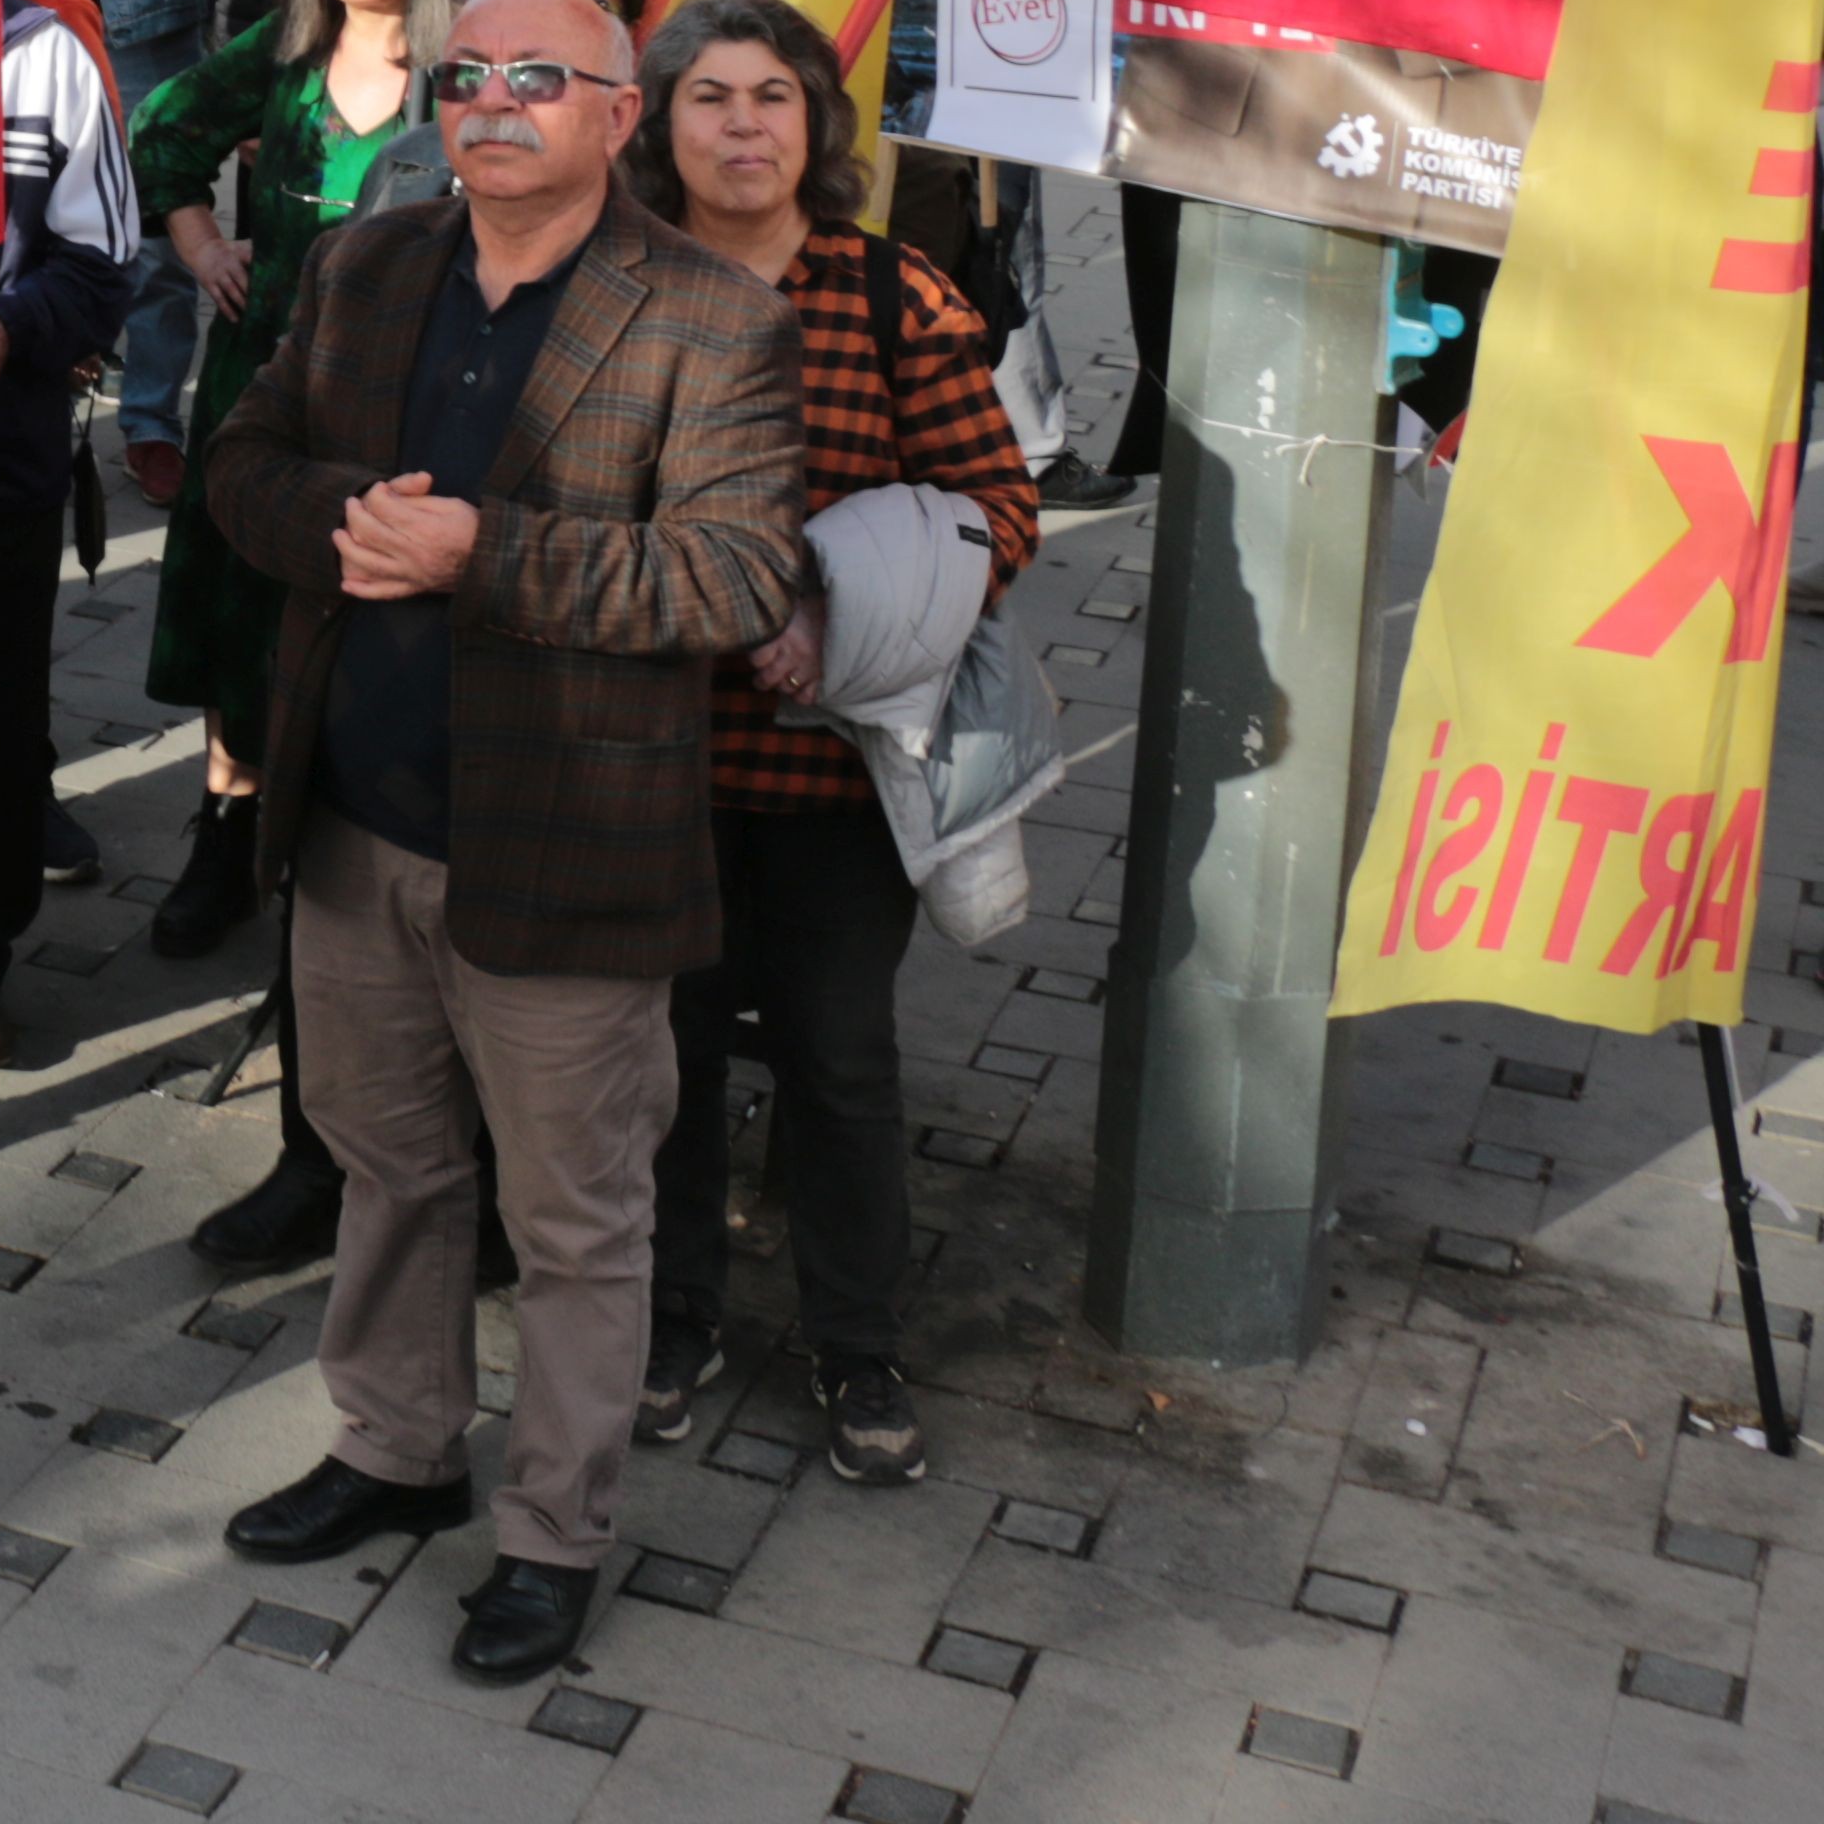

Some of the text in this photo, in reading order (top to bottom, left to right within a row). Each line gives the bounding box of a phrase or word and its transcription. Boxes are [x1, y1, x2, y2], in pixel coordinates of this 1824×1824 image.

[1407, 124, 1523, 168] TÜRKİYE
[1400, 170, 1505, 210] PARTİSİ
[1403, 149, 1524, 191] KOMÜNİS
